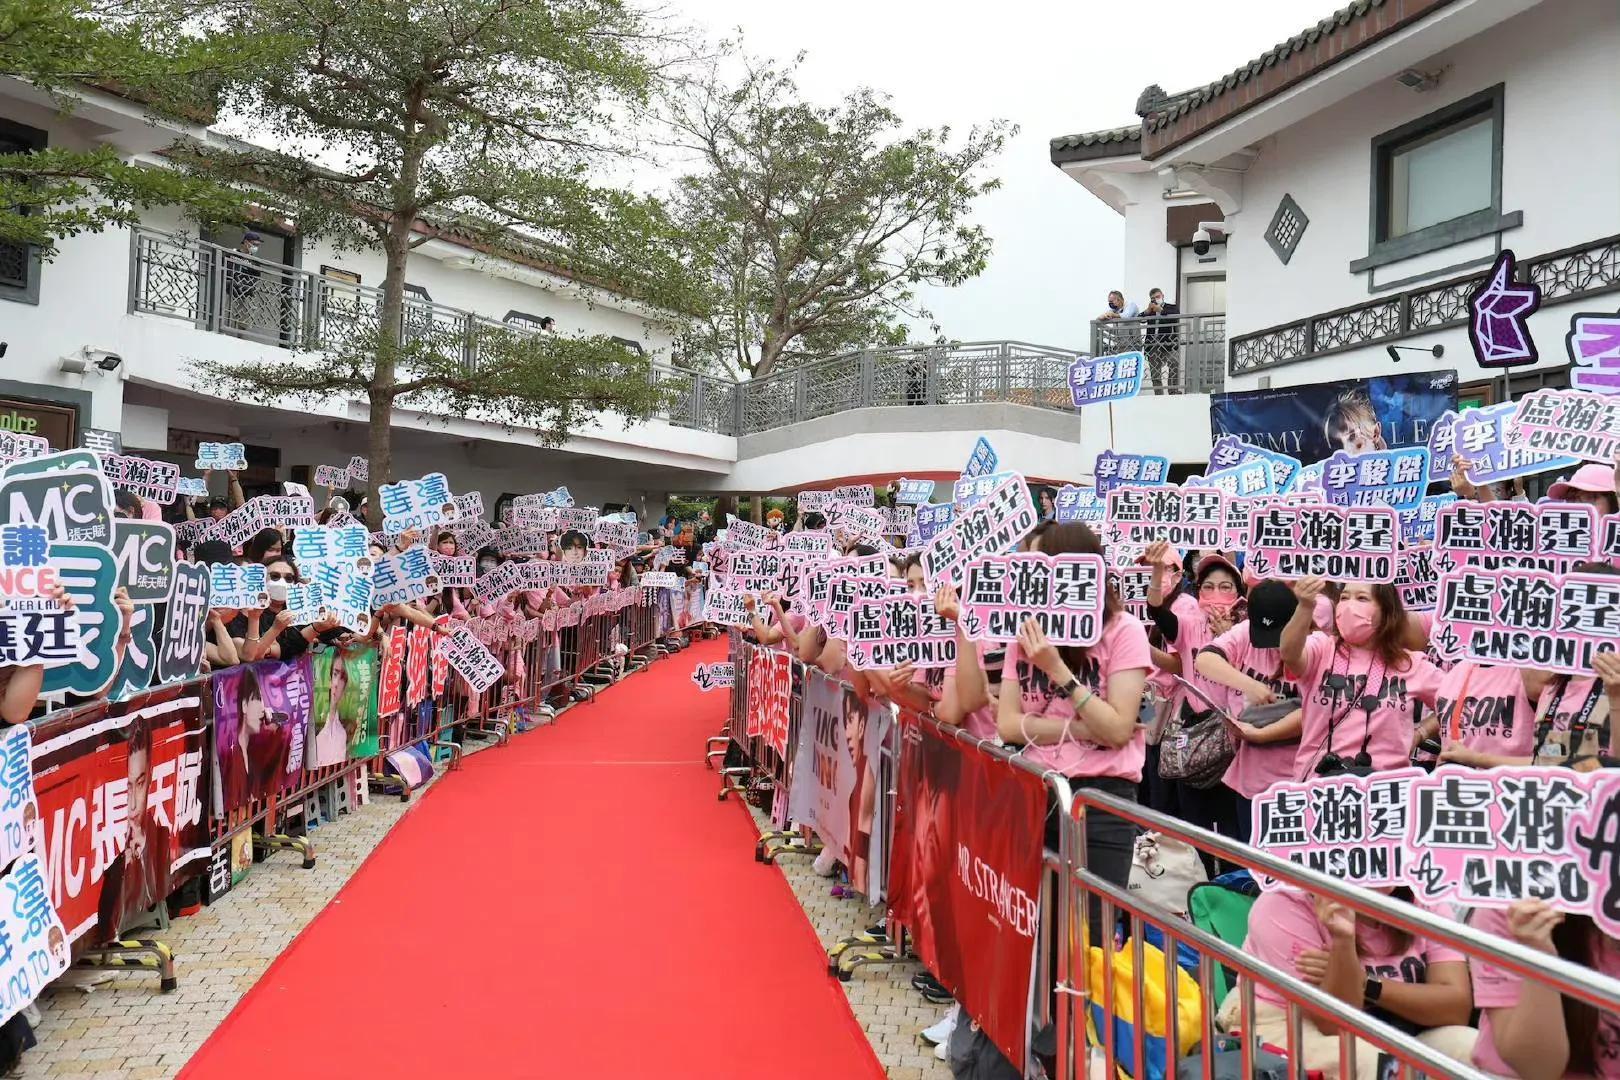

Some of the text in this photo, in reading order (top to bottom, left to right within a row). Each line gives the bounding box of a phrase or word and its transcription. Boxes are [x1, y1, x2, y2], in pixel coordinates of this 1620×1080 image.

[1090, 381, 1137, 399] JEREMY
[1328, 456, 1423, 488] 李駿傑
[1012, 510, 1031, 536] LO
[1111, 491, 1219, 522] 盧瀚霆
[69, 525, 106, 541] 張天賦
[926, 481, 1022, 578] 盧瀚霆
[1200, 528, 1218, 545] LO
[1254, 511, 1392, 551] 盧瀚霆
[1441, 508, 1590, 555] 盧瀚霆
[212, 564, 265, 592] 姜濤
[1280, 554, 1388, 578] ANSON LO
[969, 561, 1097, 607] 盧瀚霆
[1442, 575, 1620, 636] 盧瀚霆
[1071, 614, 1094, 639] LO
[452, 629, 500, 678] 盧瀚霆
[872, 640, 956, 664] ANSON LO
[1471, 630, 1577, 667] ANSON
[448, 649, 477, 682] ANSON
[1579, 692, 1598, 722] SONY
[1260, 779, 1409, 842] 盧瀚霆
[1417, 779, 1587, 850] 盧瀚
[1464, 857, 1589, 902] ANSO
[975, 857, 1037, 937] STRANGER
